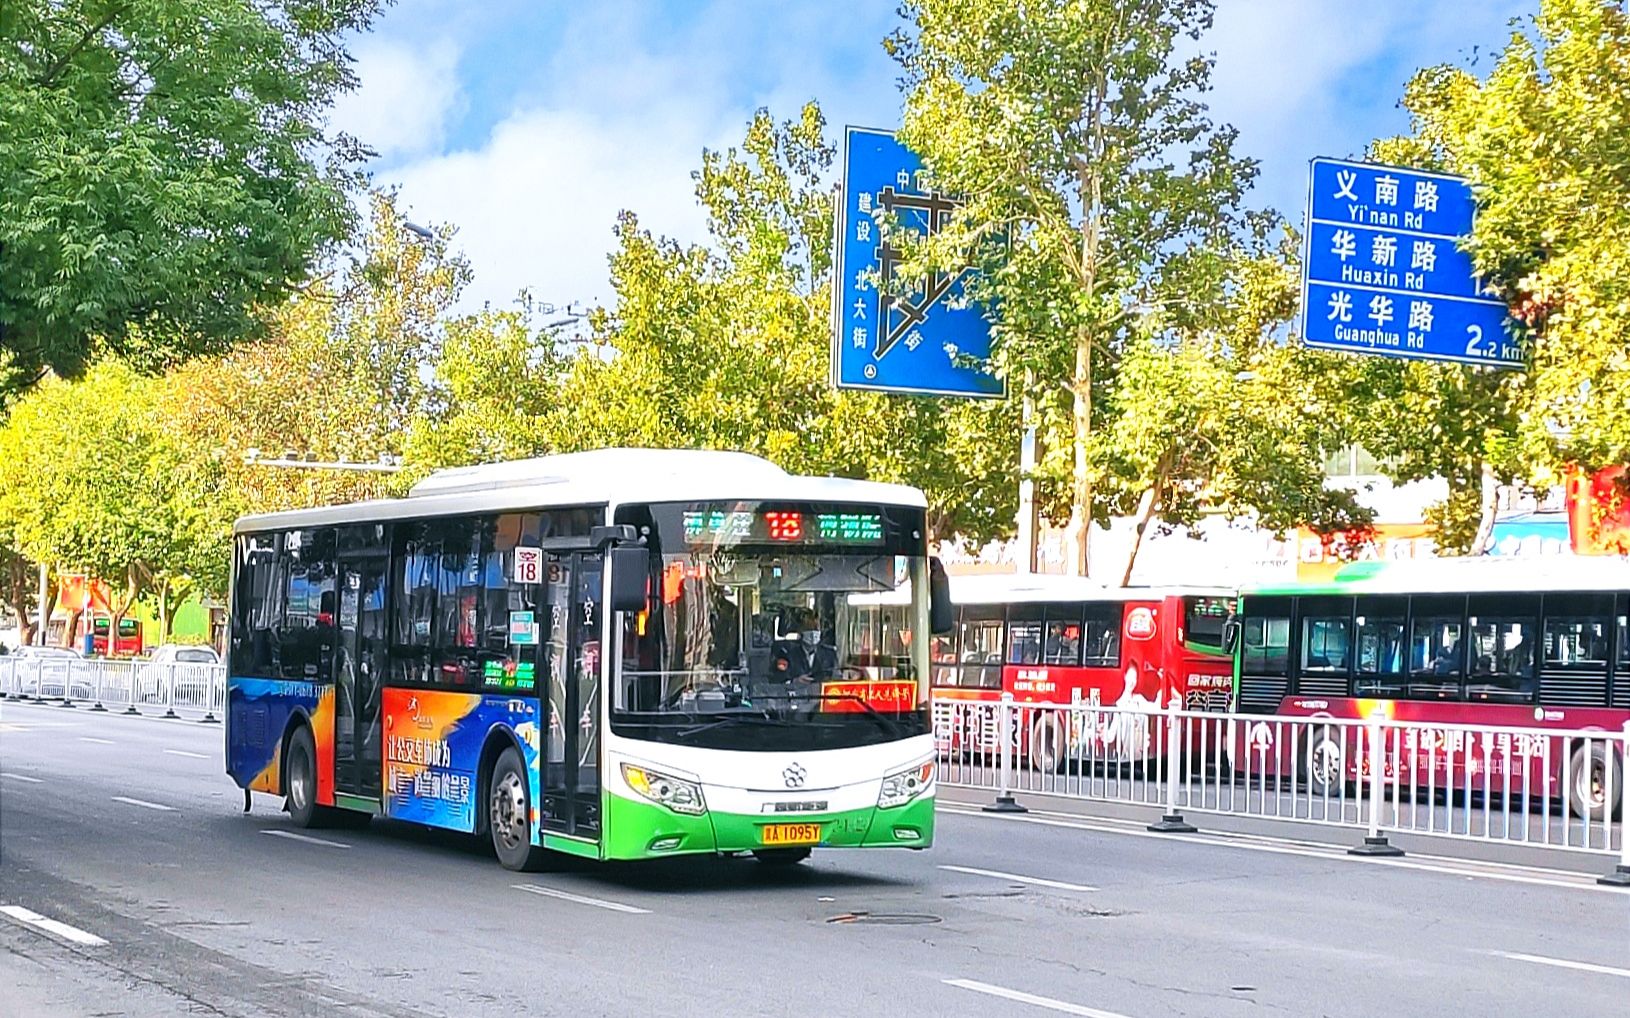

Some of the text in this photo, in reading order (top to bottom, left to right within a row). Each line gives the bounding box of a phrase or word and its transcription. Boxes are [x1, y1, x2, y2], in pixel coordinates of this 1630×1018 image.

[1333, 169, 1440, 213] 义南路
[1404, 211, 1423, 230] Rd
[1330, 229, 1437, 273] 华新路
[1341, 264, 1424, 290] Huaxin Rd
[1327, 290, 1435, 333] 光华路
[1334, 323, 1424, 349] Guanghua Rd
[1465, 324, 1497, 358] 2.2
[518, 563, 536, 582] 18
